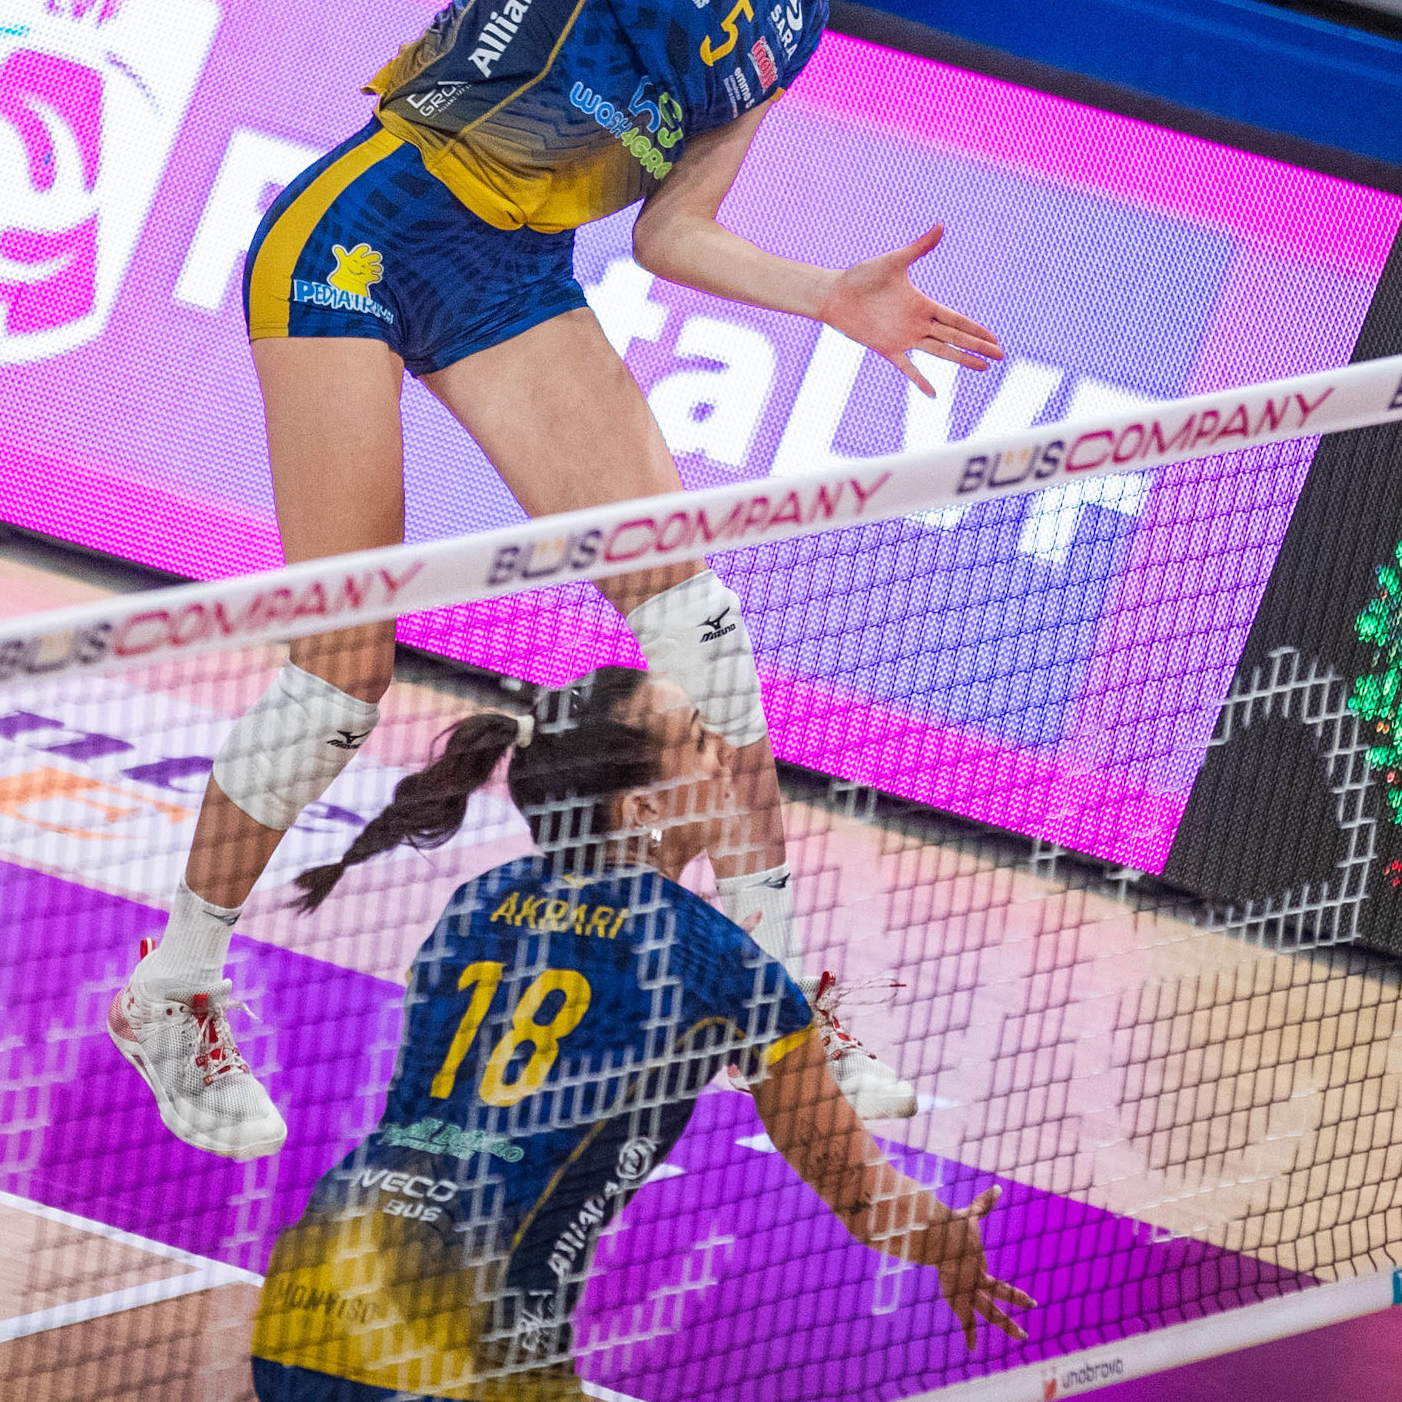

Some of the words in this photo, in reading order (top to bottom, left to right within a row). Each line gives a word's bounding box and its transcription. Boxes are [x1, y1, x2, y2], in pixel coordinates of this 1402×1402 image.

[771, 4, 798, 60] SARA
[489, 891, 629, 940] AKRARI
[429, 960, 592, 1107] 18
[350, 1168, 459, 1203] IVECO
[383, 1199, 443, 1223] BUS
